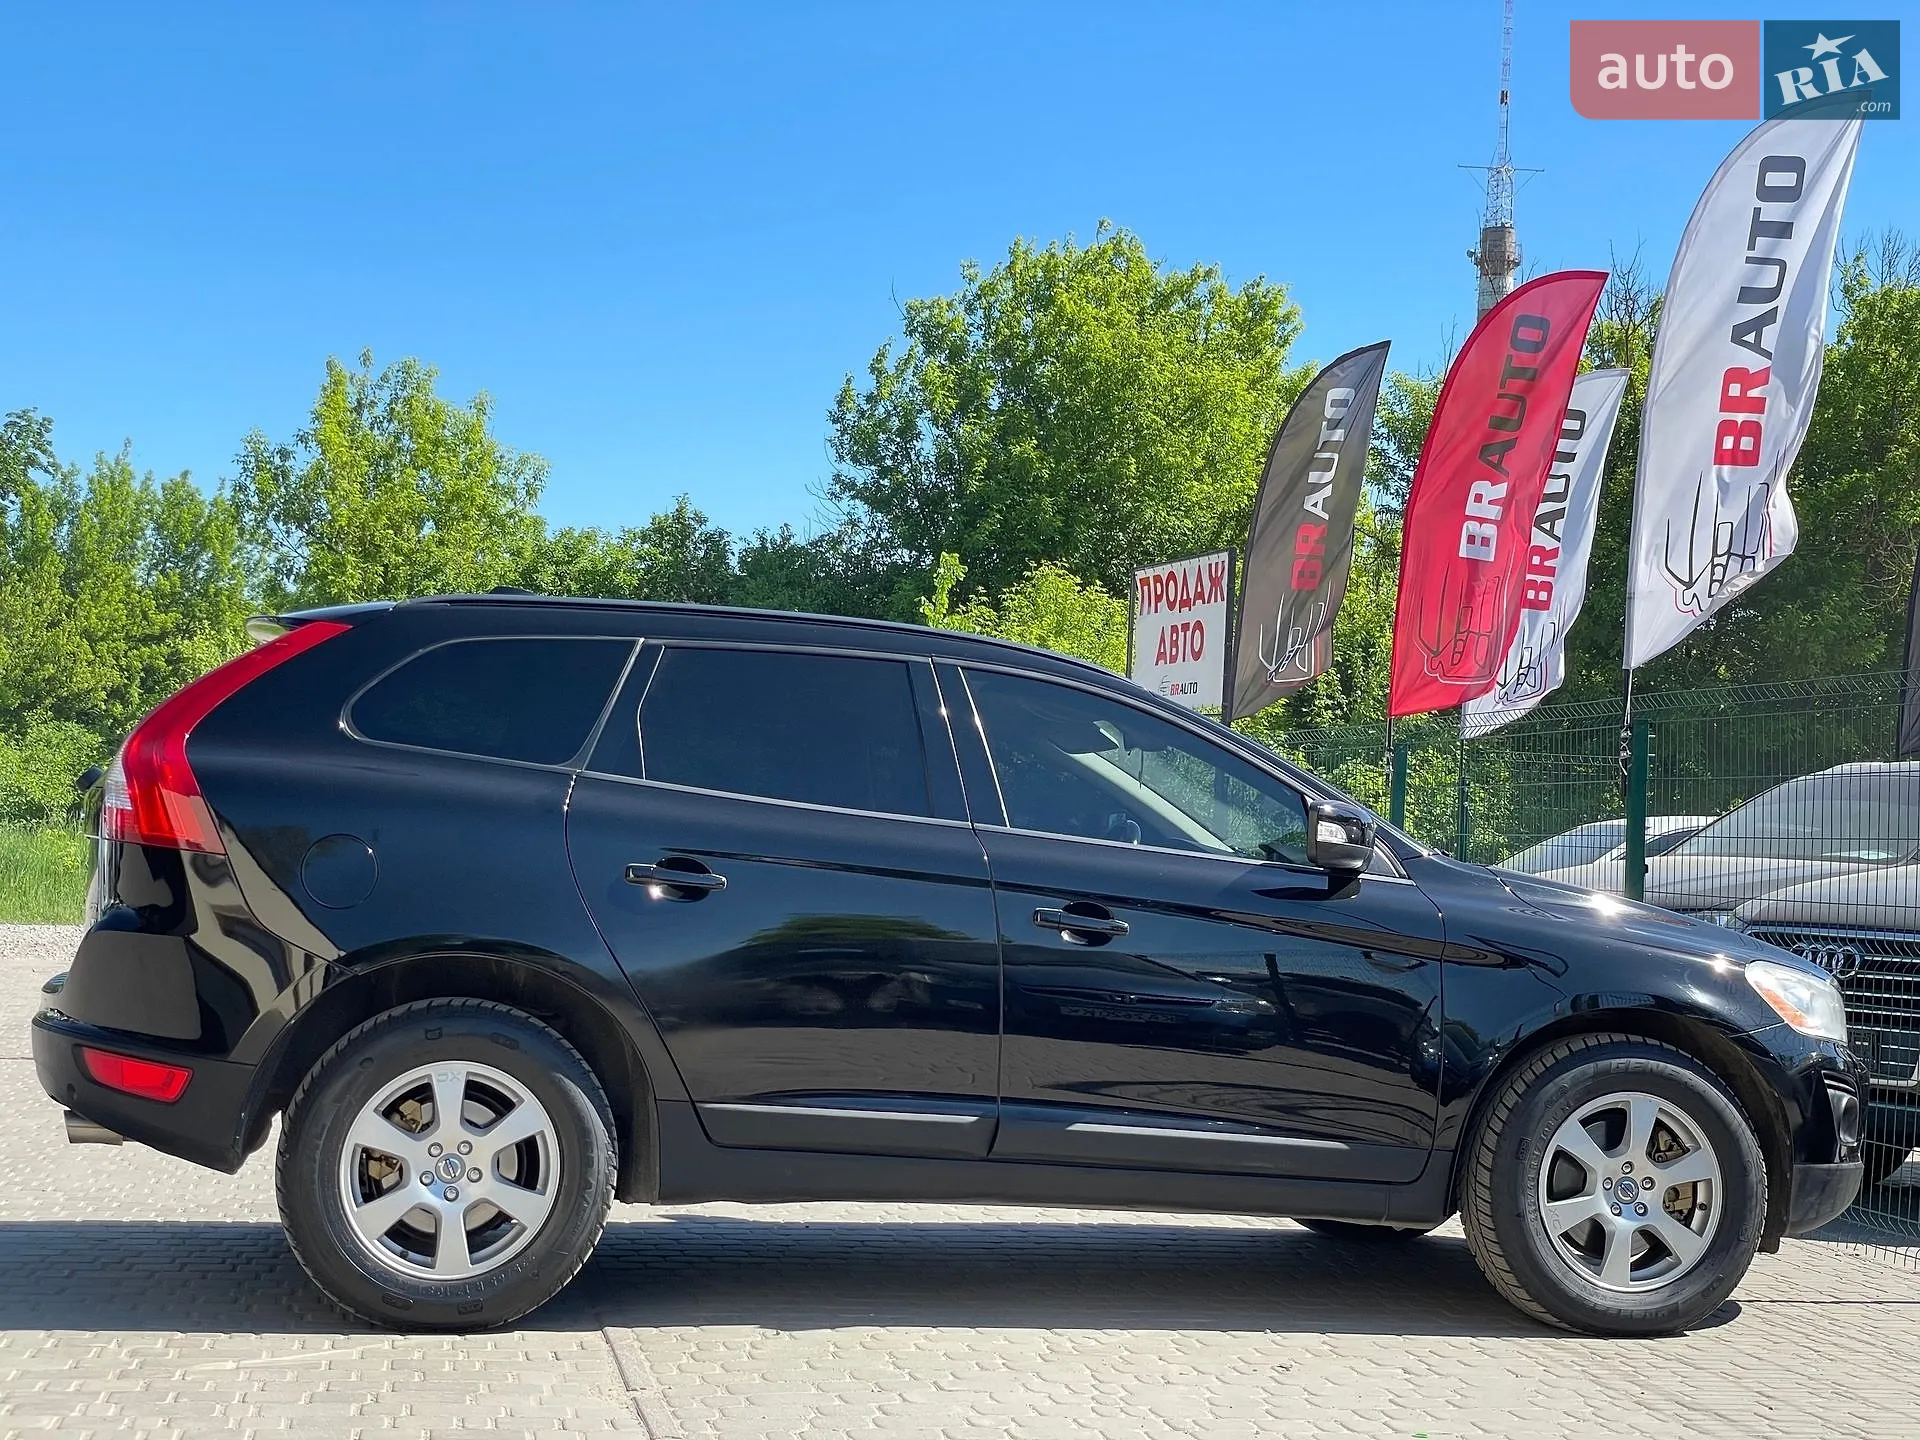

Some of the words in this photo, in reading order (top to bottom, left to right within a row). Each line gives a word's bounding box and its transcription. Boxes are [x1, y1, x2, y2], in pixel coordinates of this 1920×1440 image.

[1713, 155, 1807, 467] BRAUTO
[1290, 387, 1356, 591] BRAUTO
[1459, 314, 1551, 561] BRAUTO
[1139, 560, 1226, 616] ПРОДАЖ
[1154, 619, 1205, 667] АВТО
[1170, 681, 1198, 696] BRAUTO
